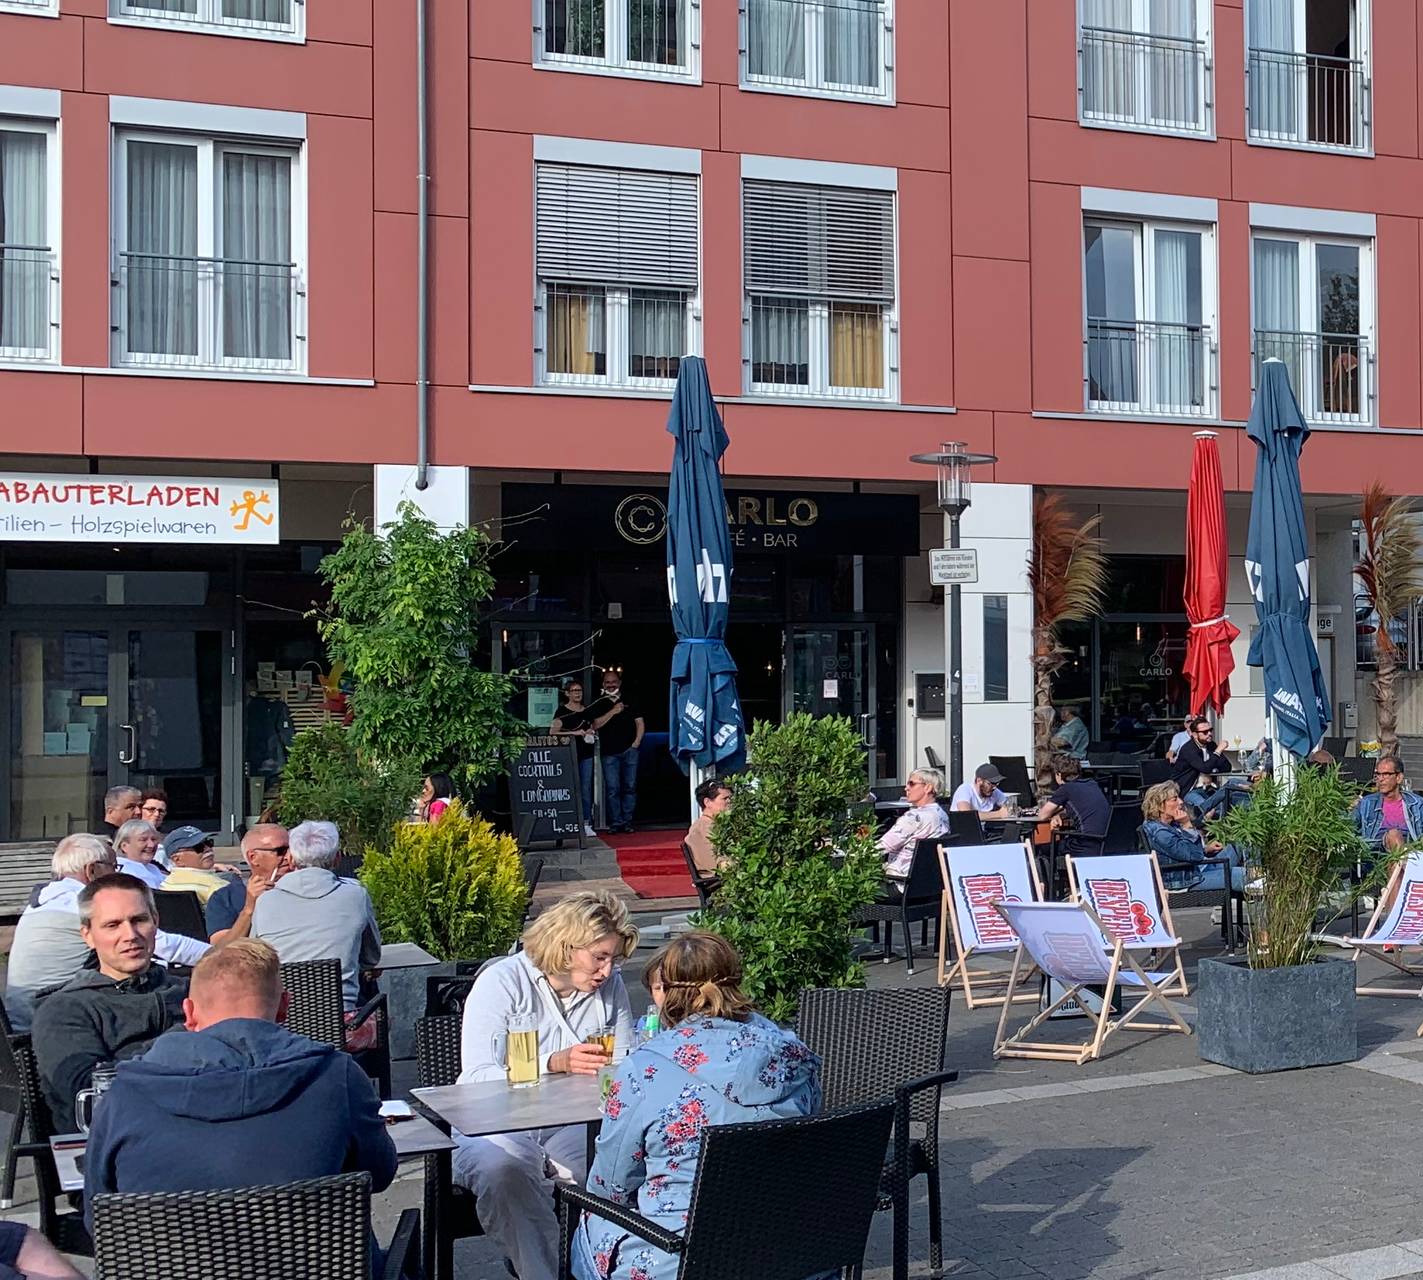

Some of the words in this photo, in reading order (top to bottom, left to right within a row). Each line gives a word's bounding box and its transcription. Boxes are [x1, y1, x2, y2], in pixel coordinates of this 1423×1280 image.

[725, 496, 818, 527] RLO
[71, 514, 216, 538] Holzspielwaren
[763, 532, 798, 548] BAR
[1139, 667, 1173, 677] CARLO
[528, 750, 552, 763] ALLE
